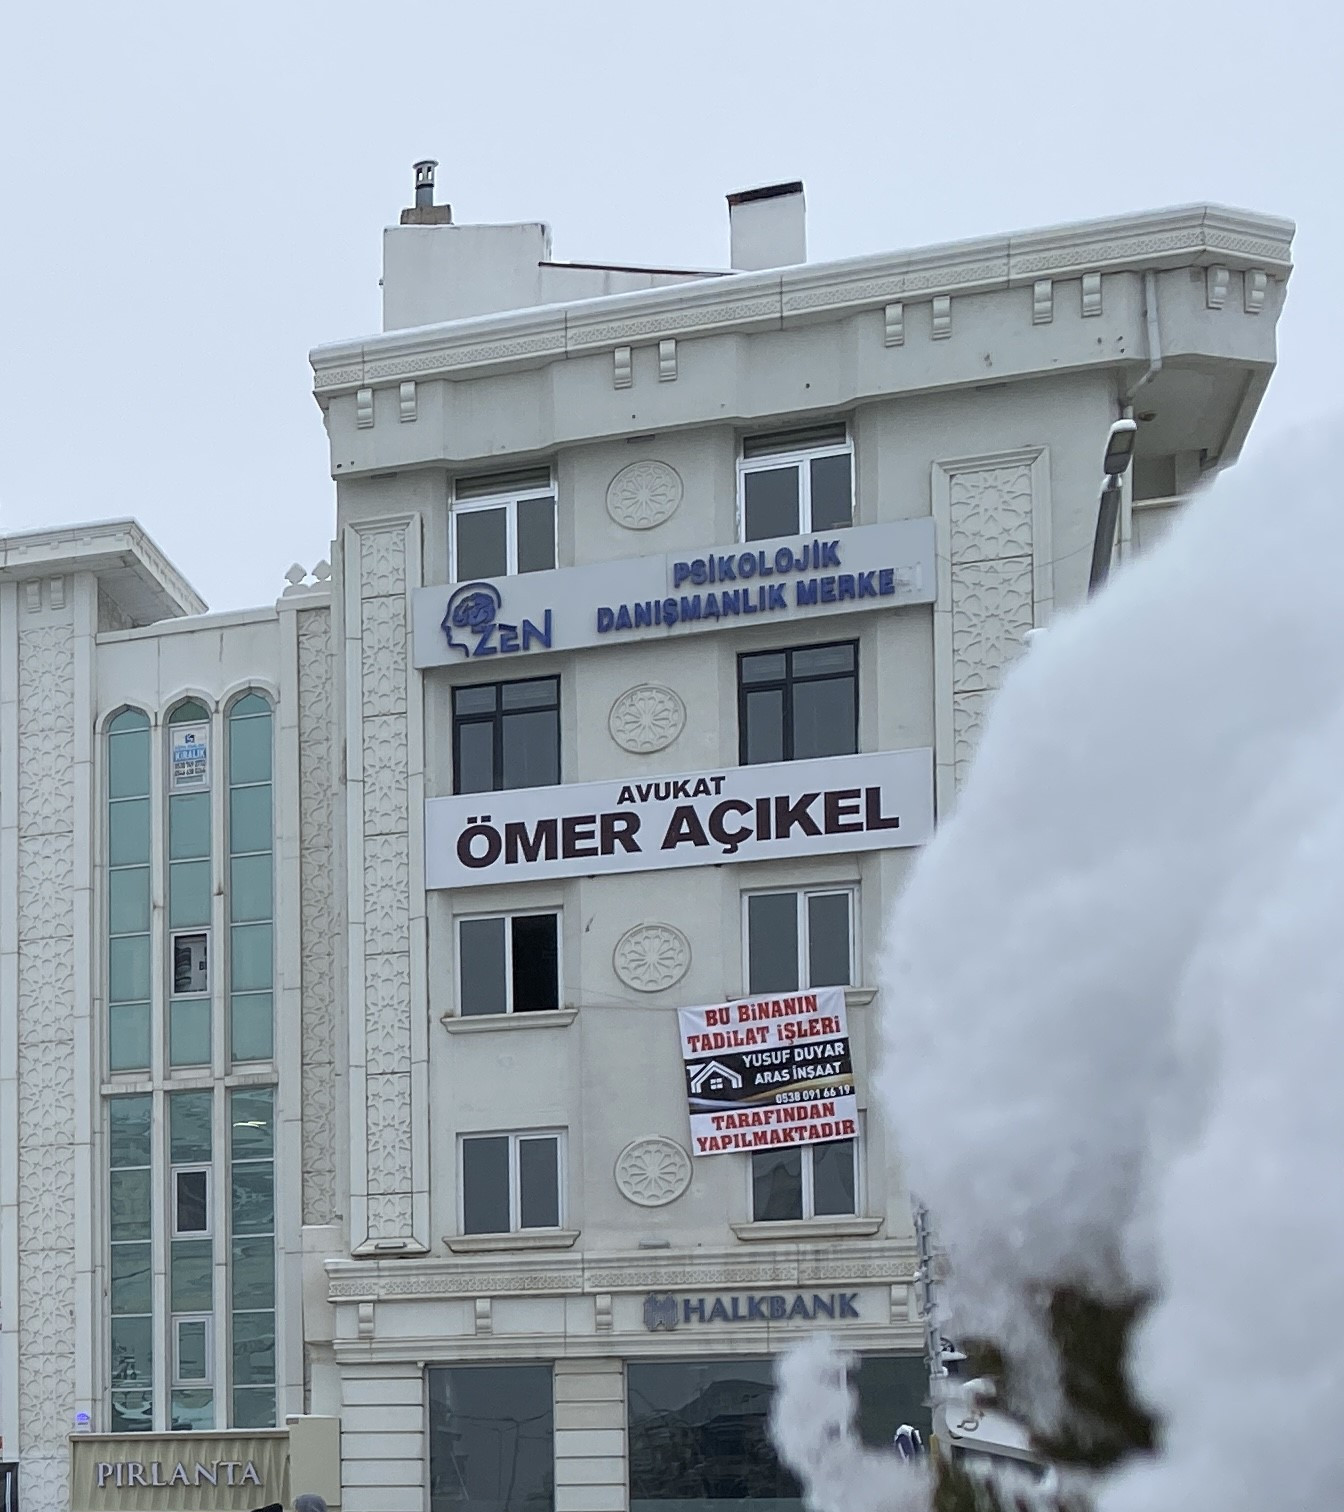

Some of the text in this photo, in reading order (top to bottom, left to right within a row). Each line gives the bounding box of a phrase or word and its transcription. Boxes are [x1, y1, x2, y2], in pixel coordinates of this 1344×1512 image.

[673, 539, 841, 589] PSİKOLOJİK
[597, 581, 788, 633] DANIŞMANLIK
[472, 608, 552, 657] ZEN
[616, 775, 726, 806] AVUKAT
[456, 785, 900, 869] ÖMER AÇIKEL
[705, 1007, 731, 1027] BU
[742, 1042, 845, 1068] YUSUF DUYAR
[754, 1061, 842, 1085] ARAS İNŞAAT
[775, 1084, 851, 1104] 0538 091 66 19
[711, 1101, 836, 1131] TARAFINDAN
[696, 1119, 856, 1152] YAPILMAKTADIR
[683, 1292, 859, 1323] HALKBANK
[96, 1460, 263, 1488] PIRLANTA
